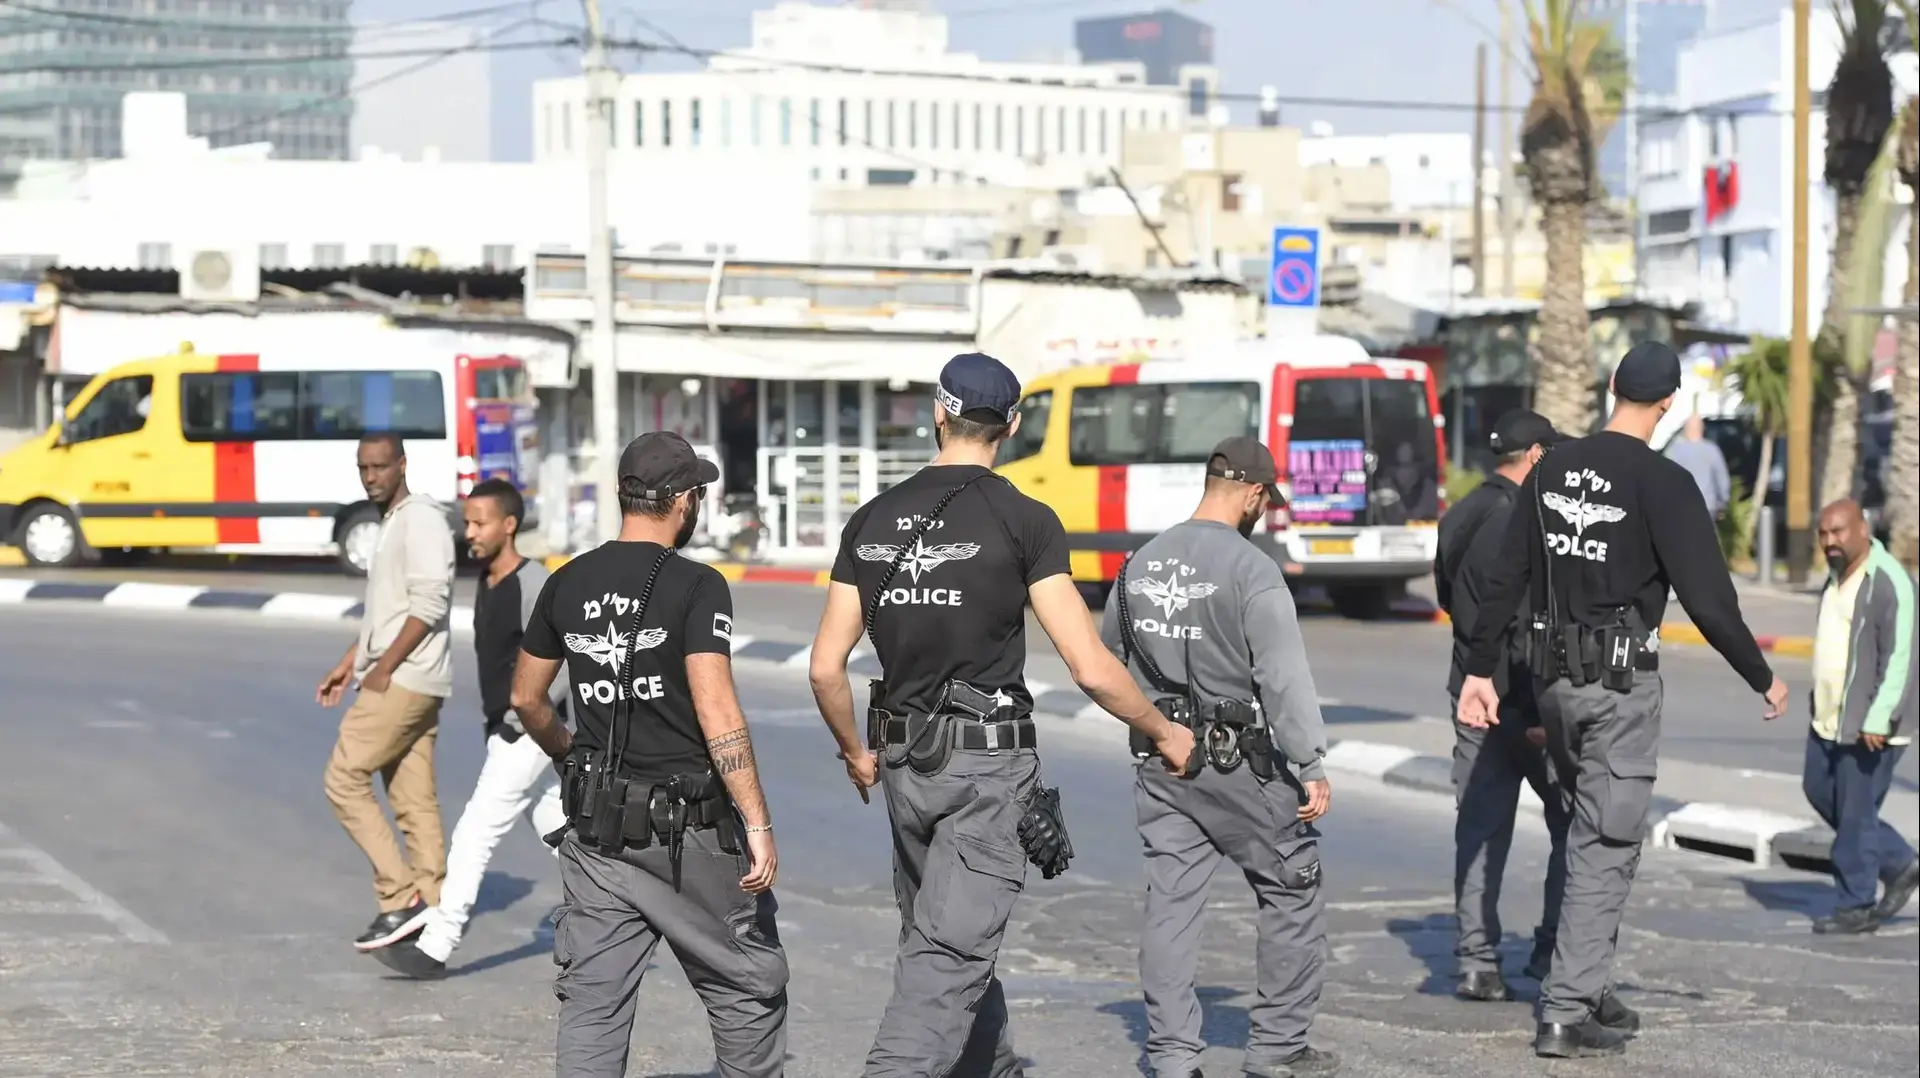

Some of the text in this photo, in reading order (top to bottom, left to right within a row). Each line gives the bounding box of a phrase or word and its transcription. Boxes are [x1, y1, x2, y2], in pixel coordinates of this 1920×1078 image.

[937, 384, 960, 412] LICE
[879, 588, 963, 607] POLICE
[1133, 619, 1203, 640] POLICE
